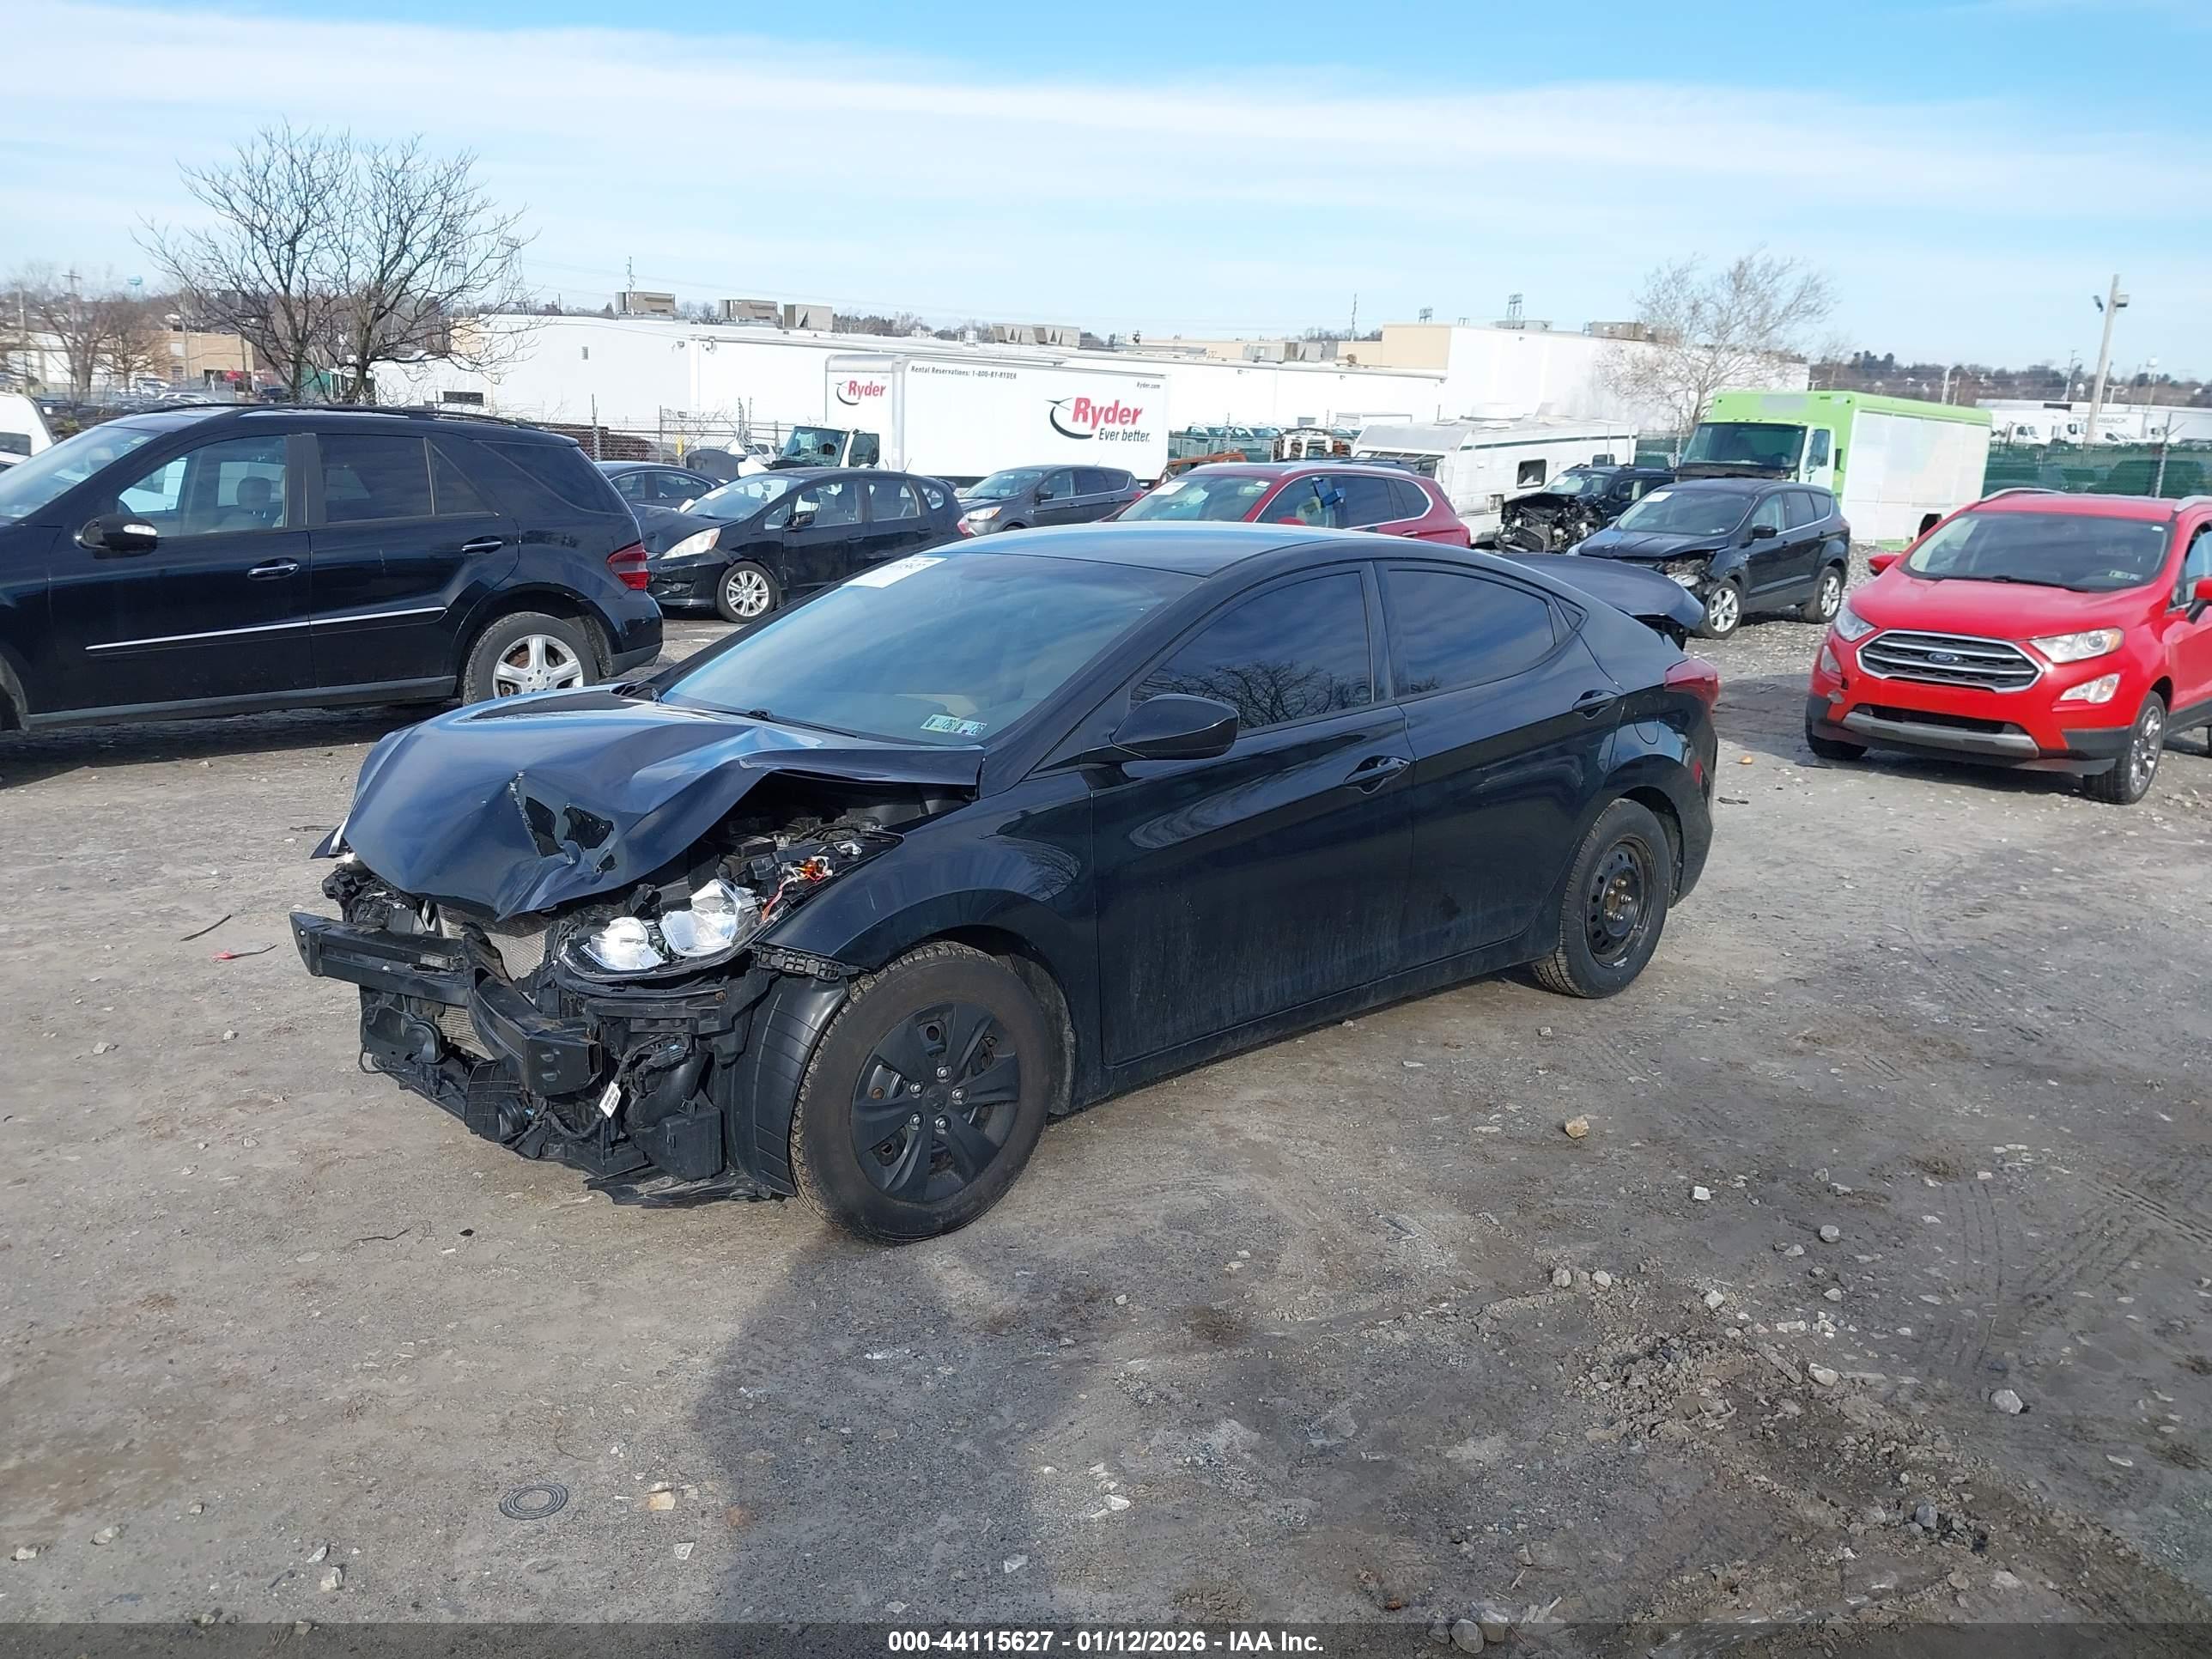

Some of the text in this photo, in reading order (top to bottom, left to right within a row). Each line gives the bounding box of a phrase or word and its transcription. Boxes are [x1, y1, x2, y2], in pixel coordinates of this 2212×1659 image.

[911, 365, 930, 374] Rental
[932, 367, 970, 377] Reservations:
[848, 380, 886, 400] Ryder
[1072, 397, 1143, 429] Ryder
[1099, 428, 1151, 442] Ever better.
